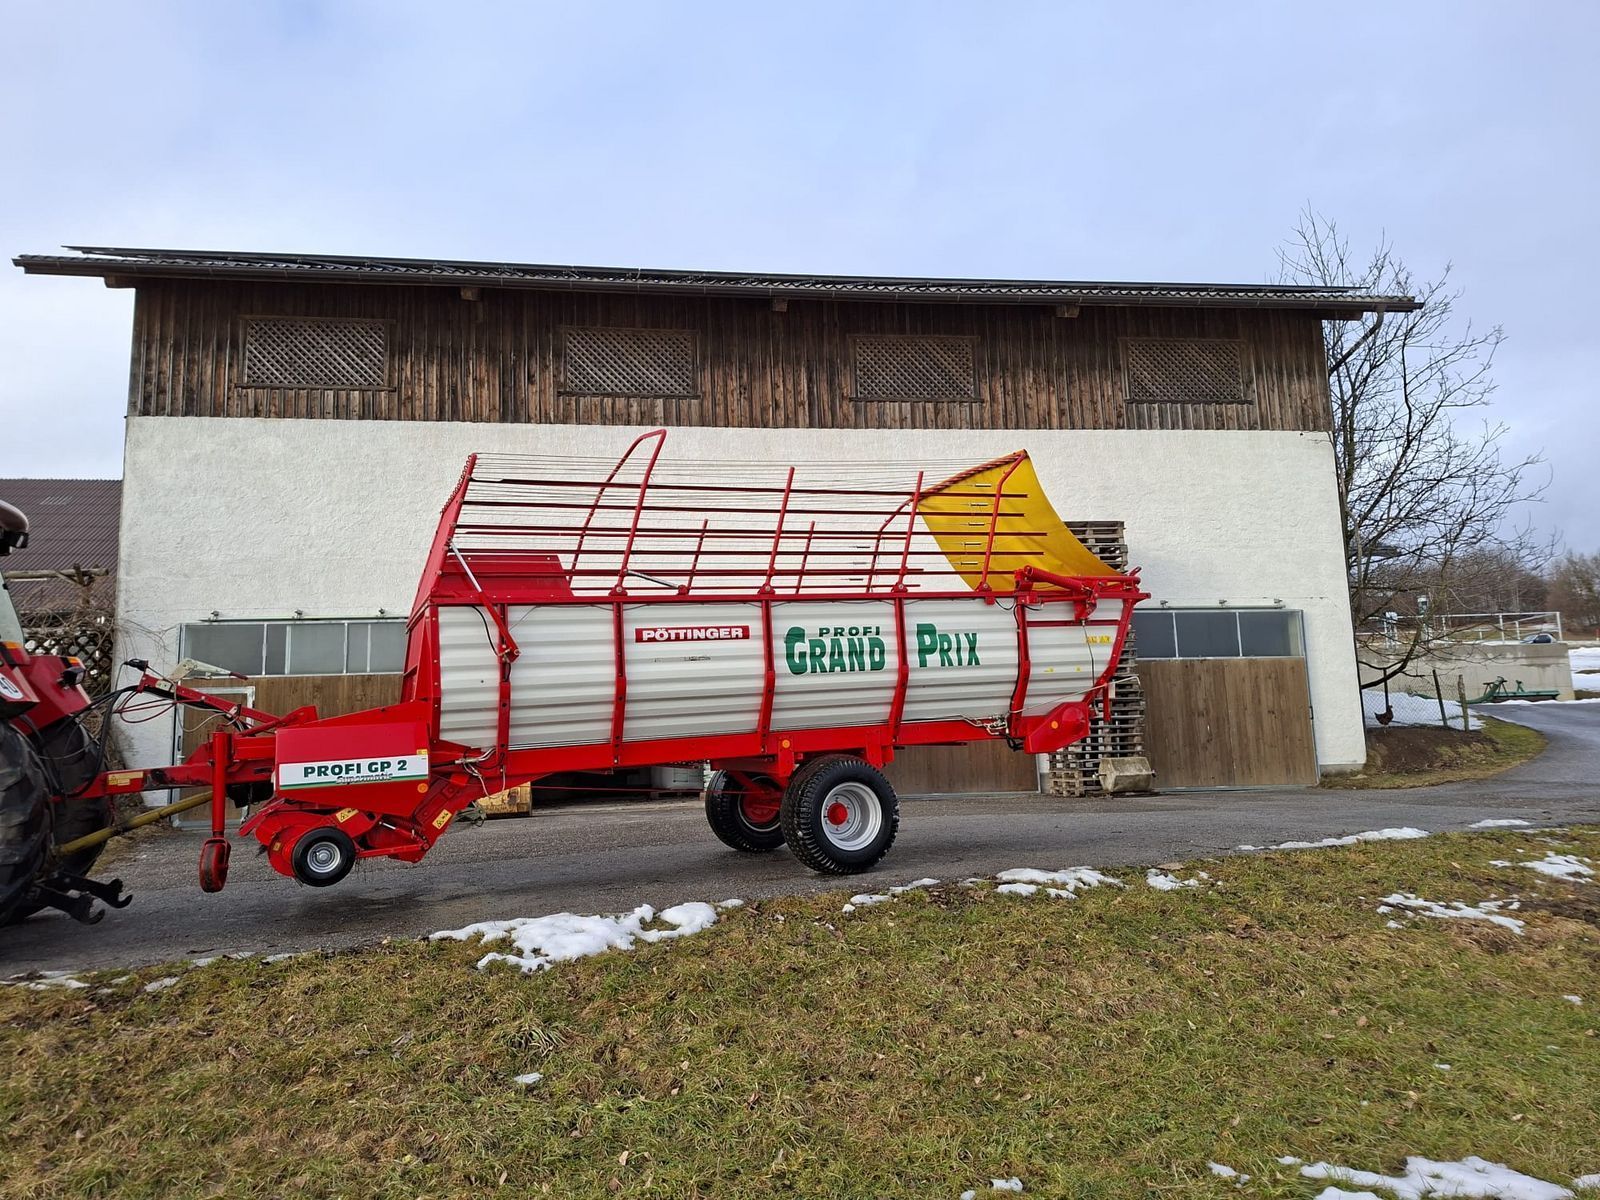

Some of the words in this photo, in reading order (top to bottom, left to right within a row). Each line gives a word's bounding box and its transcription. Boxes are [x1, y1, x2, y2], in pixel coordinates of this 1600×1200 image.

[643, 628, 743, 641] PÖTTINGER
[819, 626, 880, 637] PROFI
[784, 626, 886, 675] GRAND
[917, 623, 980, 668] PRIX
[303, 763, 362, 778] PROFI
[368, 761, 391, 773] GP
[397, 759, 407, 771] 2
